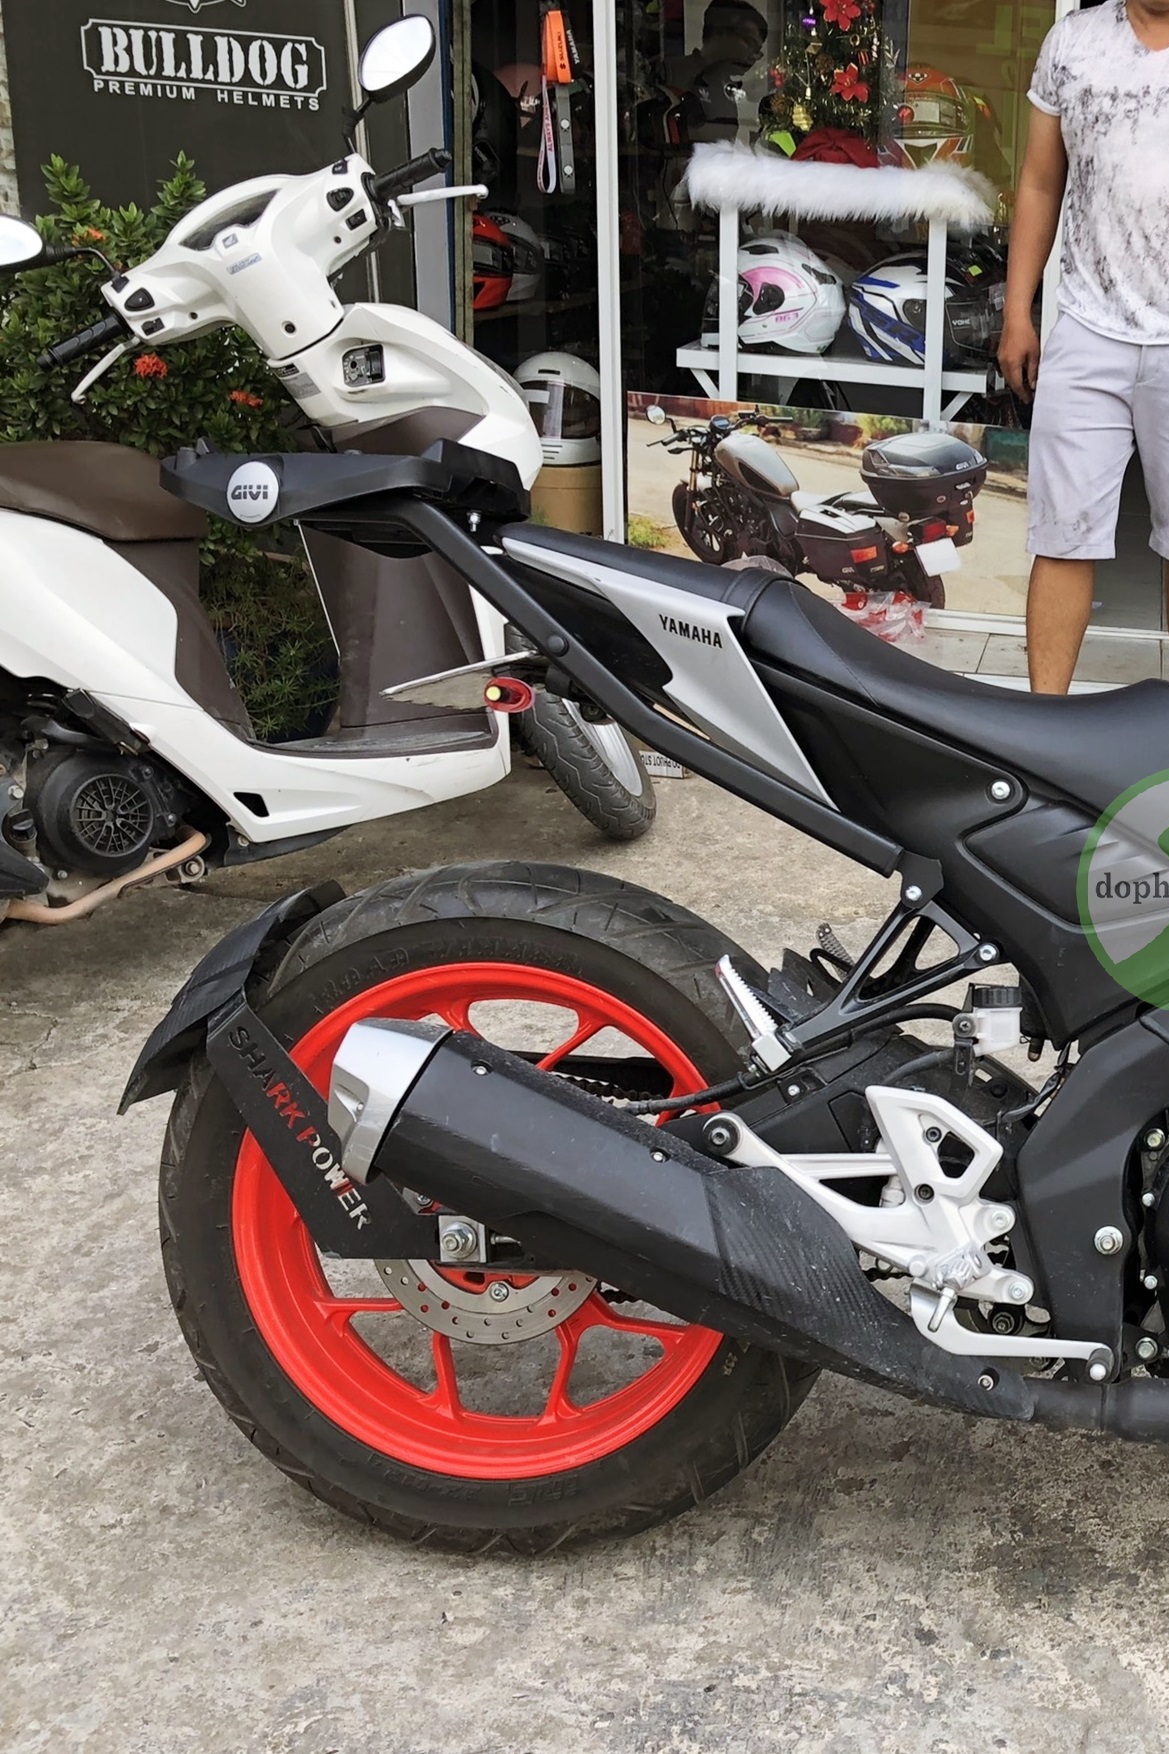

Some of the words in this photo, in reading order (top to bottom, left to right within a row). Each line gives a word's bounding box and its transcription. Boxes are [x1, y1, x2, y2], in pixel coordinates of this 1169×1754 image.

[98, 26, 309, 89] BULLDOG
[566, 29, 581, 65] YAMAHA
[93, 79, 196, 100] PREMIUM
[216, 89, 320, 111] HELMETS
[231, 484, 269, 501] GIVI
[659, 614, 723, 649] YAMAHA
[229, 1026, 306, 1130] SHARK
[296, 1126, 372, 1231] POWER
